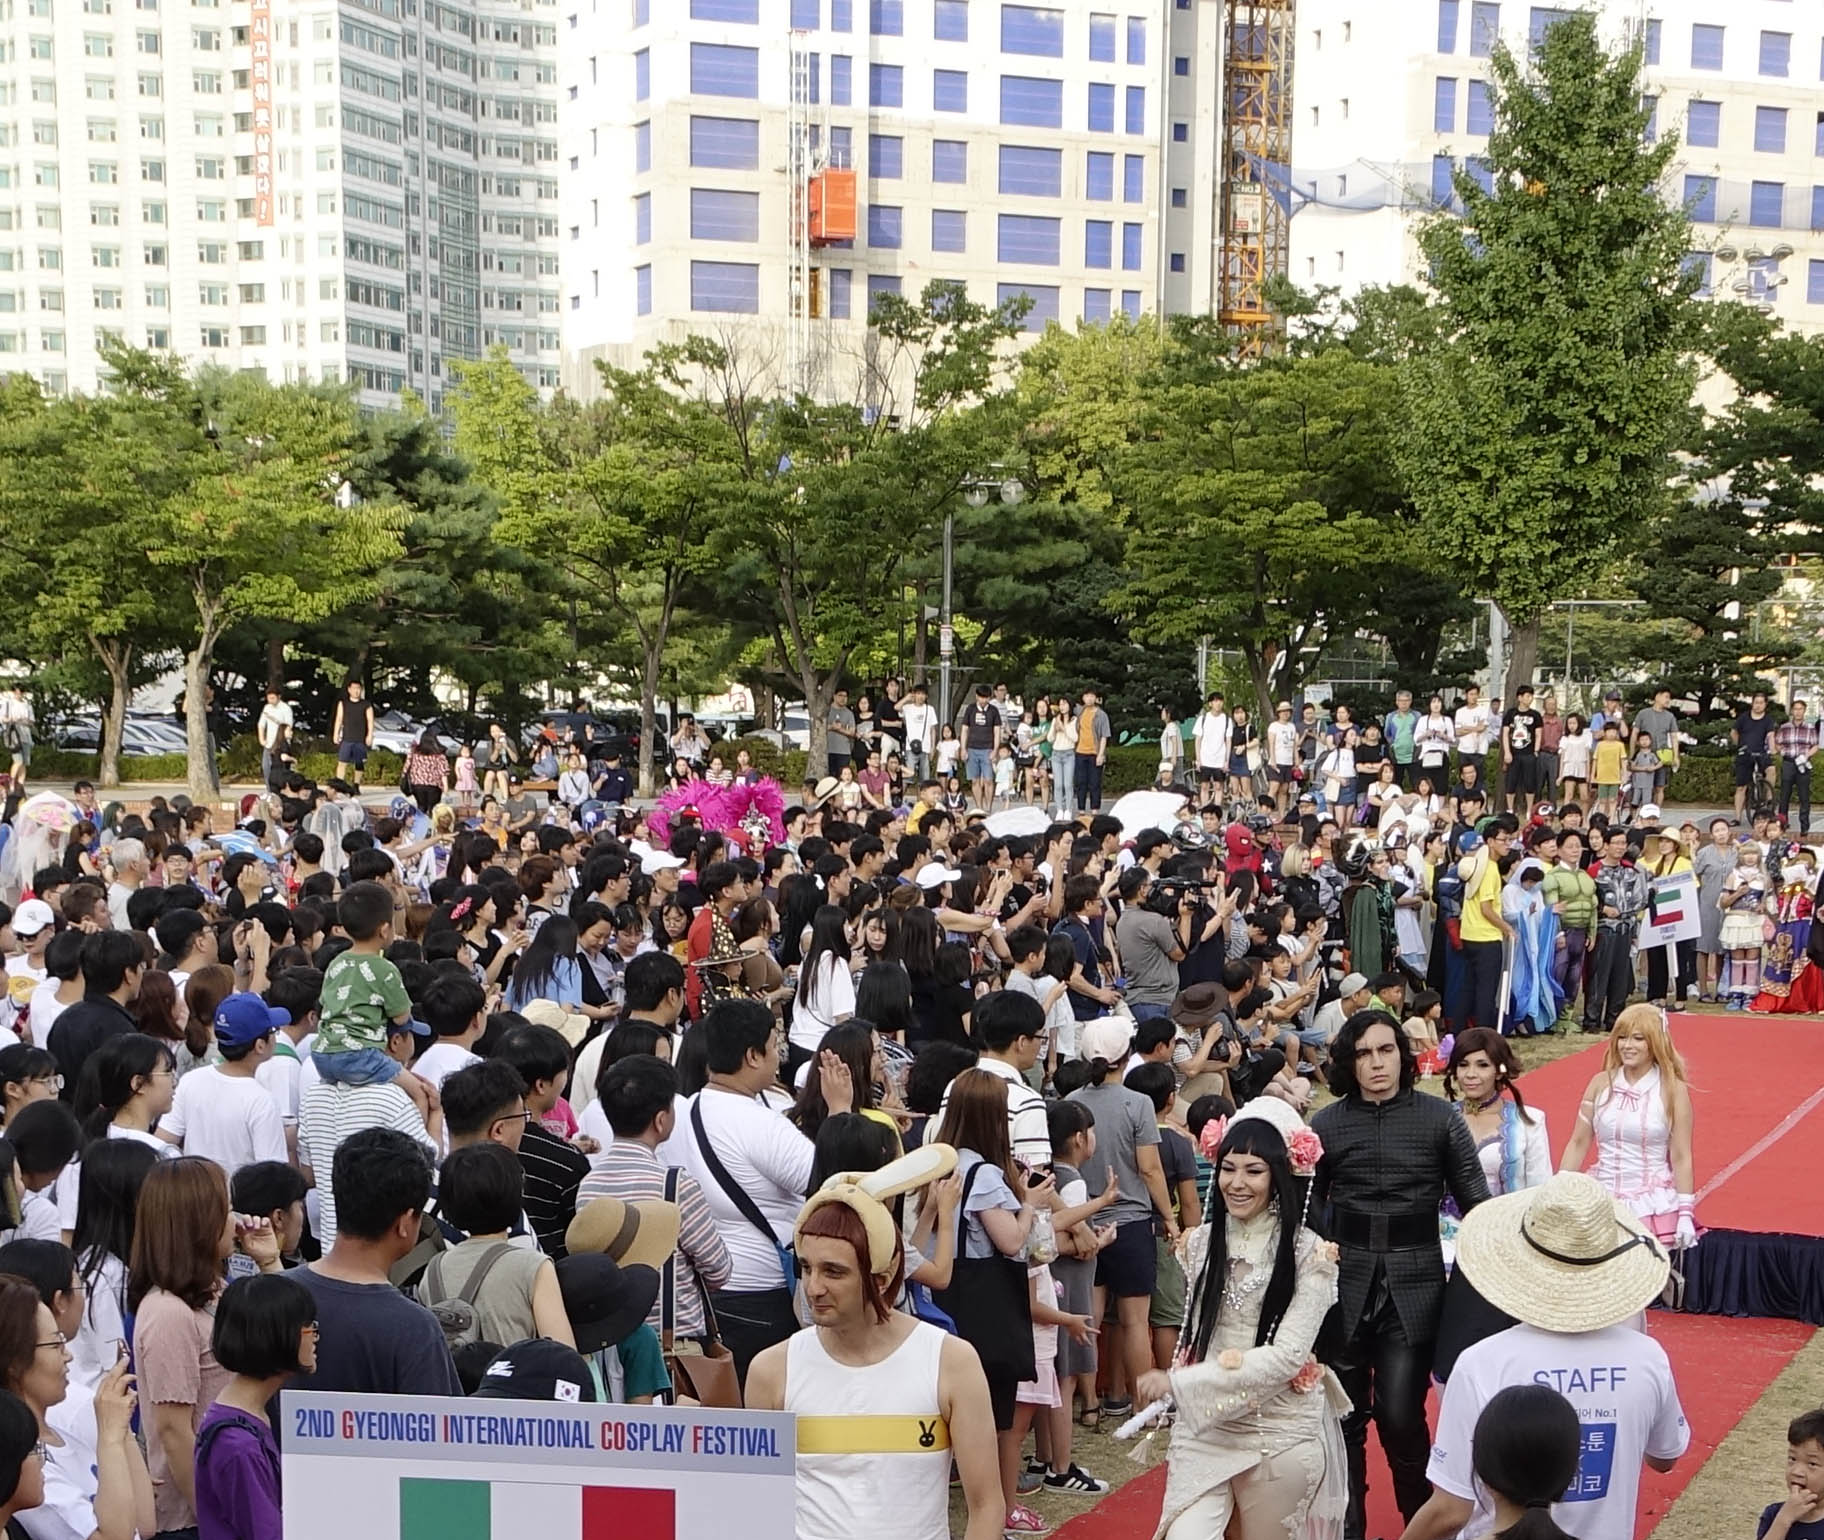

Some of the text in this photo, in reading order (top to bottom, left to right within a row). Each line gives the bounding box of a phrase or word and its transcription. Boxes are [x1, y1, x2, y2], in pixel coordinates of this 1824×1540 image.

[1533, 1366, 1627, 1394] STAFF
[1595, 1407, 1617, 1419] No.1
[295, 1409, 781, 1459] 2ND GYEONGGI INTERNATIONAL COSPLAY FESTIVAL
